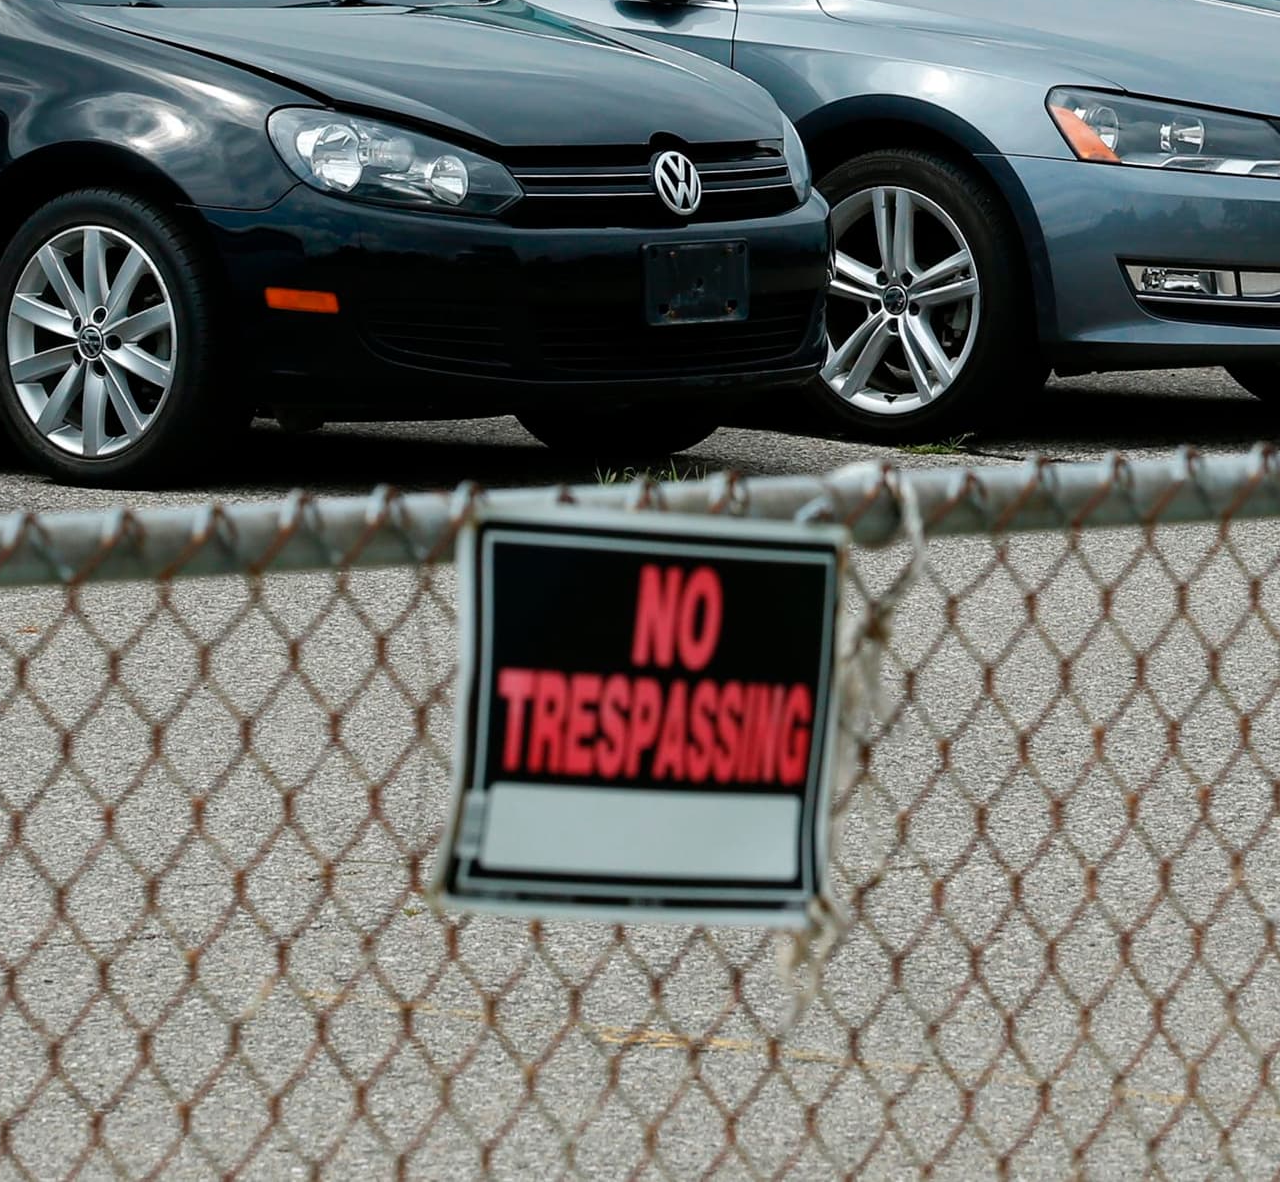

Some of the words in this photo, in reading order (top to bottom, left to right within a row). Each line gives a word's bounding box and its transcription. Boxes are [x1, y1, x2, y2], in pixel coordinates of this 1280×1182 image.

[654, 151, 702, 215] VW
[632, 566, 721, 668] NO
[498, 669, 810, 783] TRESPASSING
